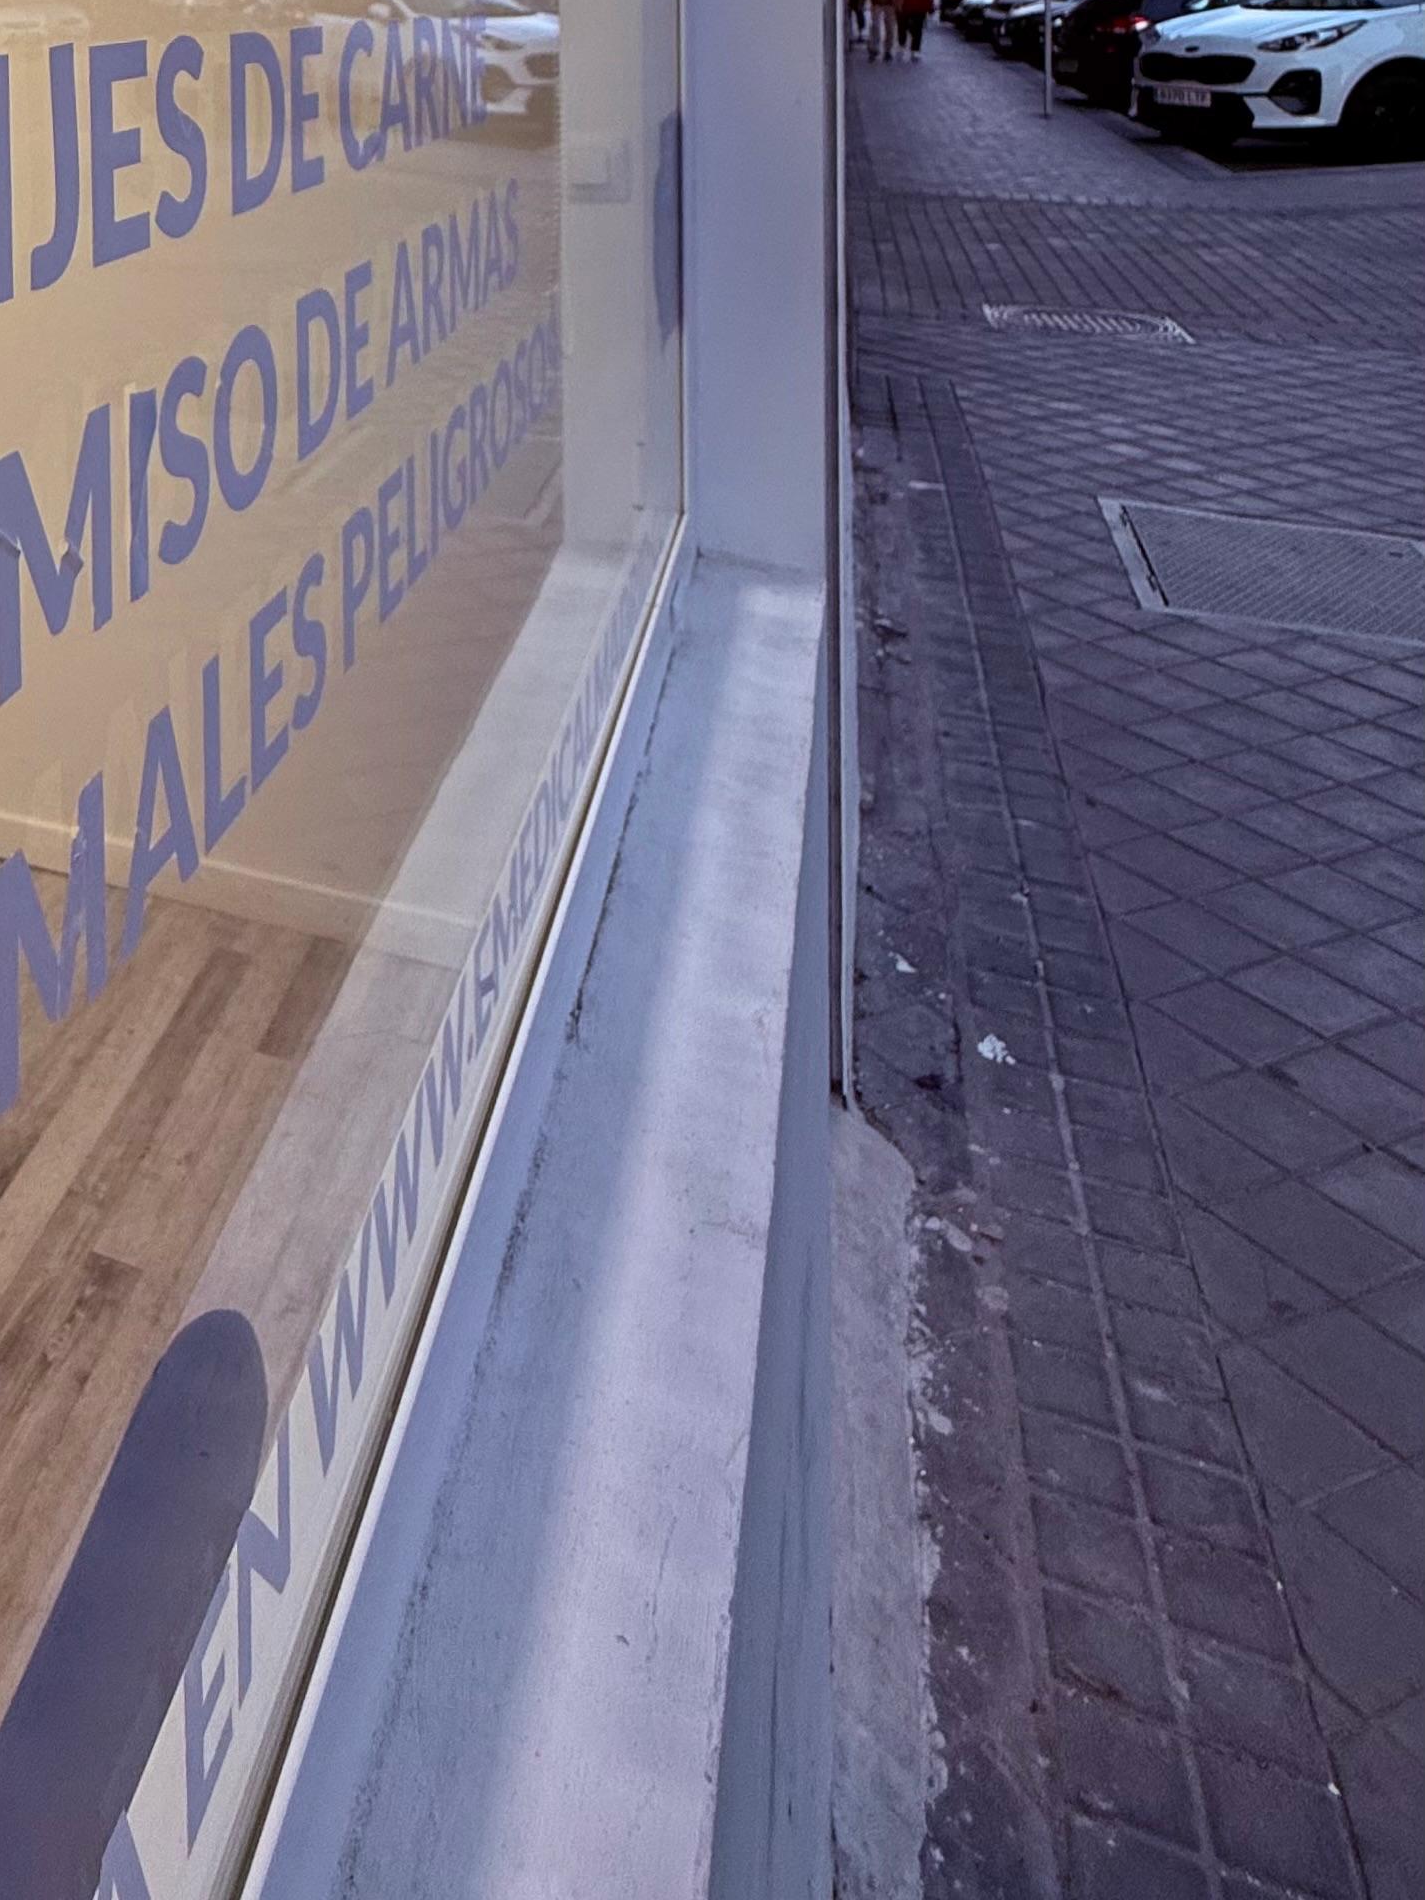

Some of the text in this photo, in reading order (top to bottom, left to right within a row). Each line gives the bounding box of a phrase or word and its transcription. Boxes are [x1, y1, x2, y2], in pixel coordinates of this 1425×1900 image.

[230, 25, 325, 217] DE
[295, 259, 374, 462] DE
[386, 178, 519, 388] ARMAS
